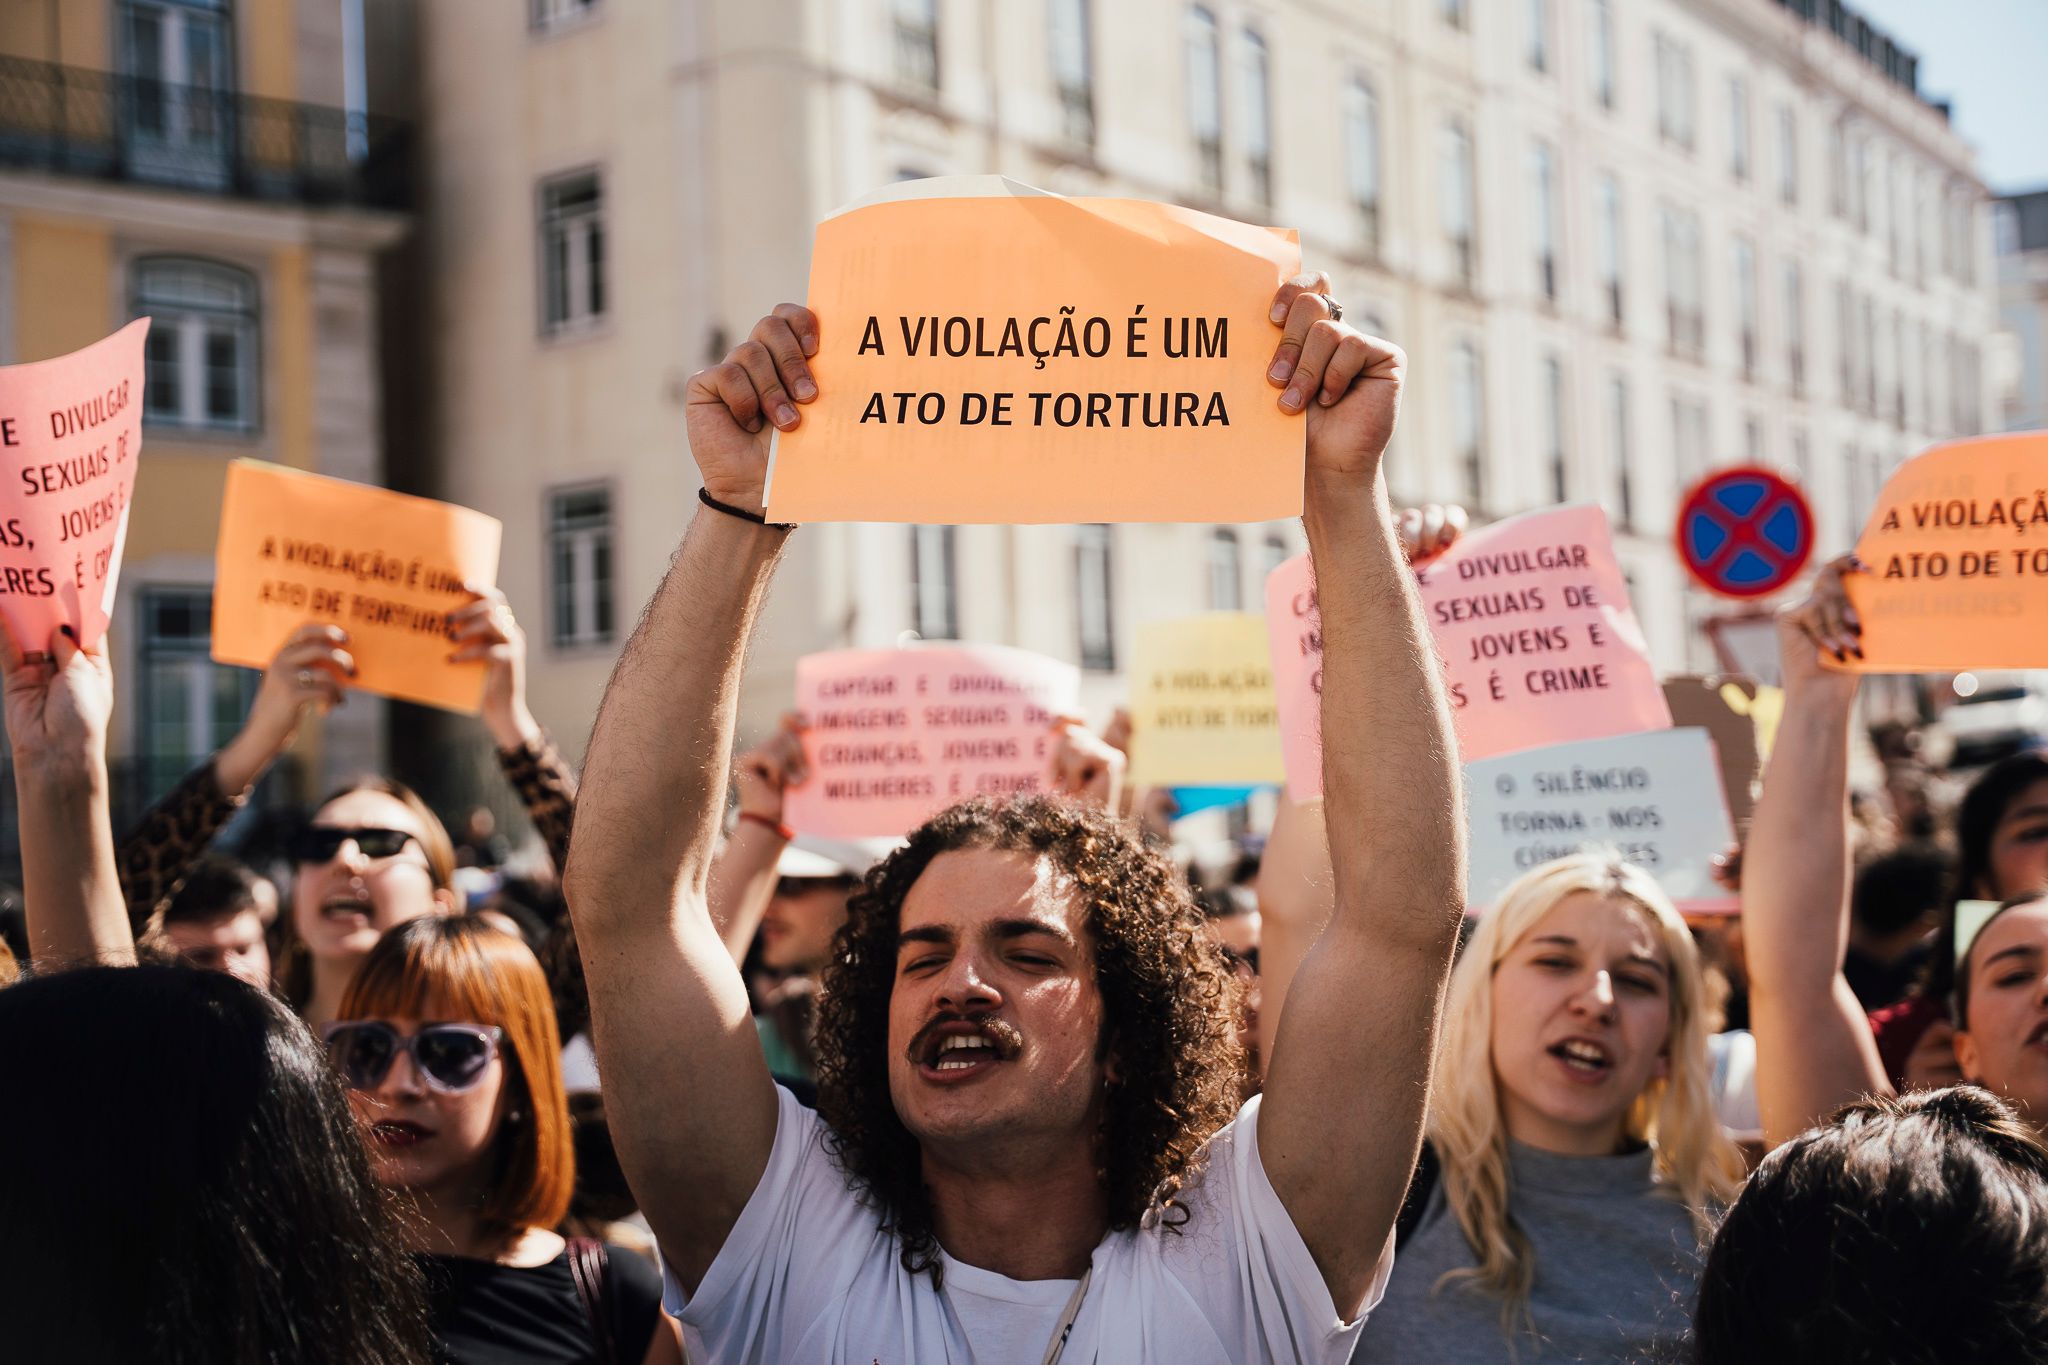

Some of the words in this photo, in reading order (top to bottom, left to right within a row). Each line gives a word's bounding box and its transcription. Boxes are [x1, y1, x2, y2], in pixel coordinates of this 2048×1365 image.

[857, 315, 887, 357] A
[898, 304, 1113, 371] VIOLAÇÃO
[1124, 303, 1149, 358] É
[1161, 316, 1230, 359] UM
[1, 418, 20, 447] E
[50, 379, 130, 440] DIVULGAR
[859, 391, 946, 426] ATO
[958, 391, 1015, 427] DE
[1026, 391, 1231, 429] TORTURA
[21, 446, 109, 496] SEXUAIS
[116, 429, 129, 464] DE
[60, 492, 114, 542] JOVENS
[1882, 508, 1900, 533] A
[1912, 489, 2048, 534] VIOLAÇÃ
[75, 552, 84, 589] É
[258, 536, 274, 558] A
[282, 541, 402, 581] VIOLAÇÃO
[407, 555, 422, 590] É
[1458, 544, 1589, 581] DIVULGAR
[1884, 552, 1948, 579] ATO
[1959, 550, 2000, 577] DE
[2011, 548, 2048, 577] TO
[259, 581, 306, 610] ATO
[311, 588, 343, 615] DE
[1434, 588, 1544, 624] SEXUAIS
[1563, 585, 1599, 609] DE
[1471, 625, 1568, 661] JOVENS
[1588, 624, 1604, 646] E
[819, 677, 895, 697] CAPTAR
[917, 676, 928, 694] E
[947, 673, 1047, 696] DIVUL
[1488, 667, 1506, 700] É
[1526, 664, 1609, 694] CRIME
[816, 709, 907, 728] IMAGENS
[924, 706, 1008, 726] SEXUAIS
[943, 741, 1017, 760] JOVENS
[1035, 739, 1046, 757] E
[826, 776, 933, 799] MULHERES
[1496, 772, 1516, 795] O
[1533, 763, 1649, 795] SILÊNCIO
[1499, 811, 1585, 832] TORNA
[1607, 804, 1662, 828] NOS
